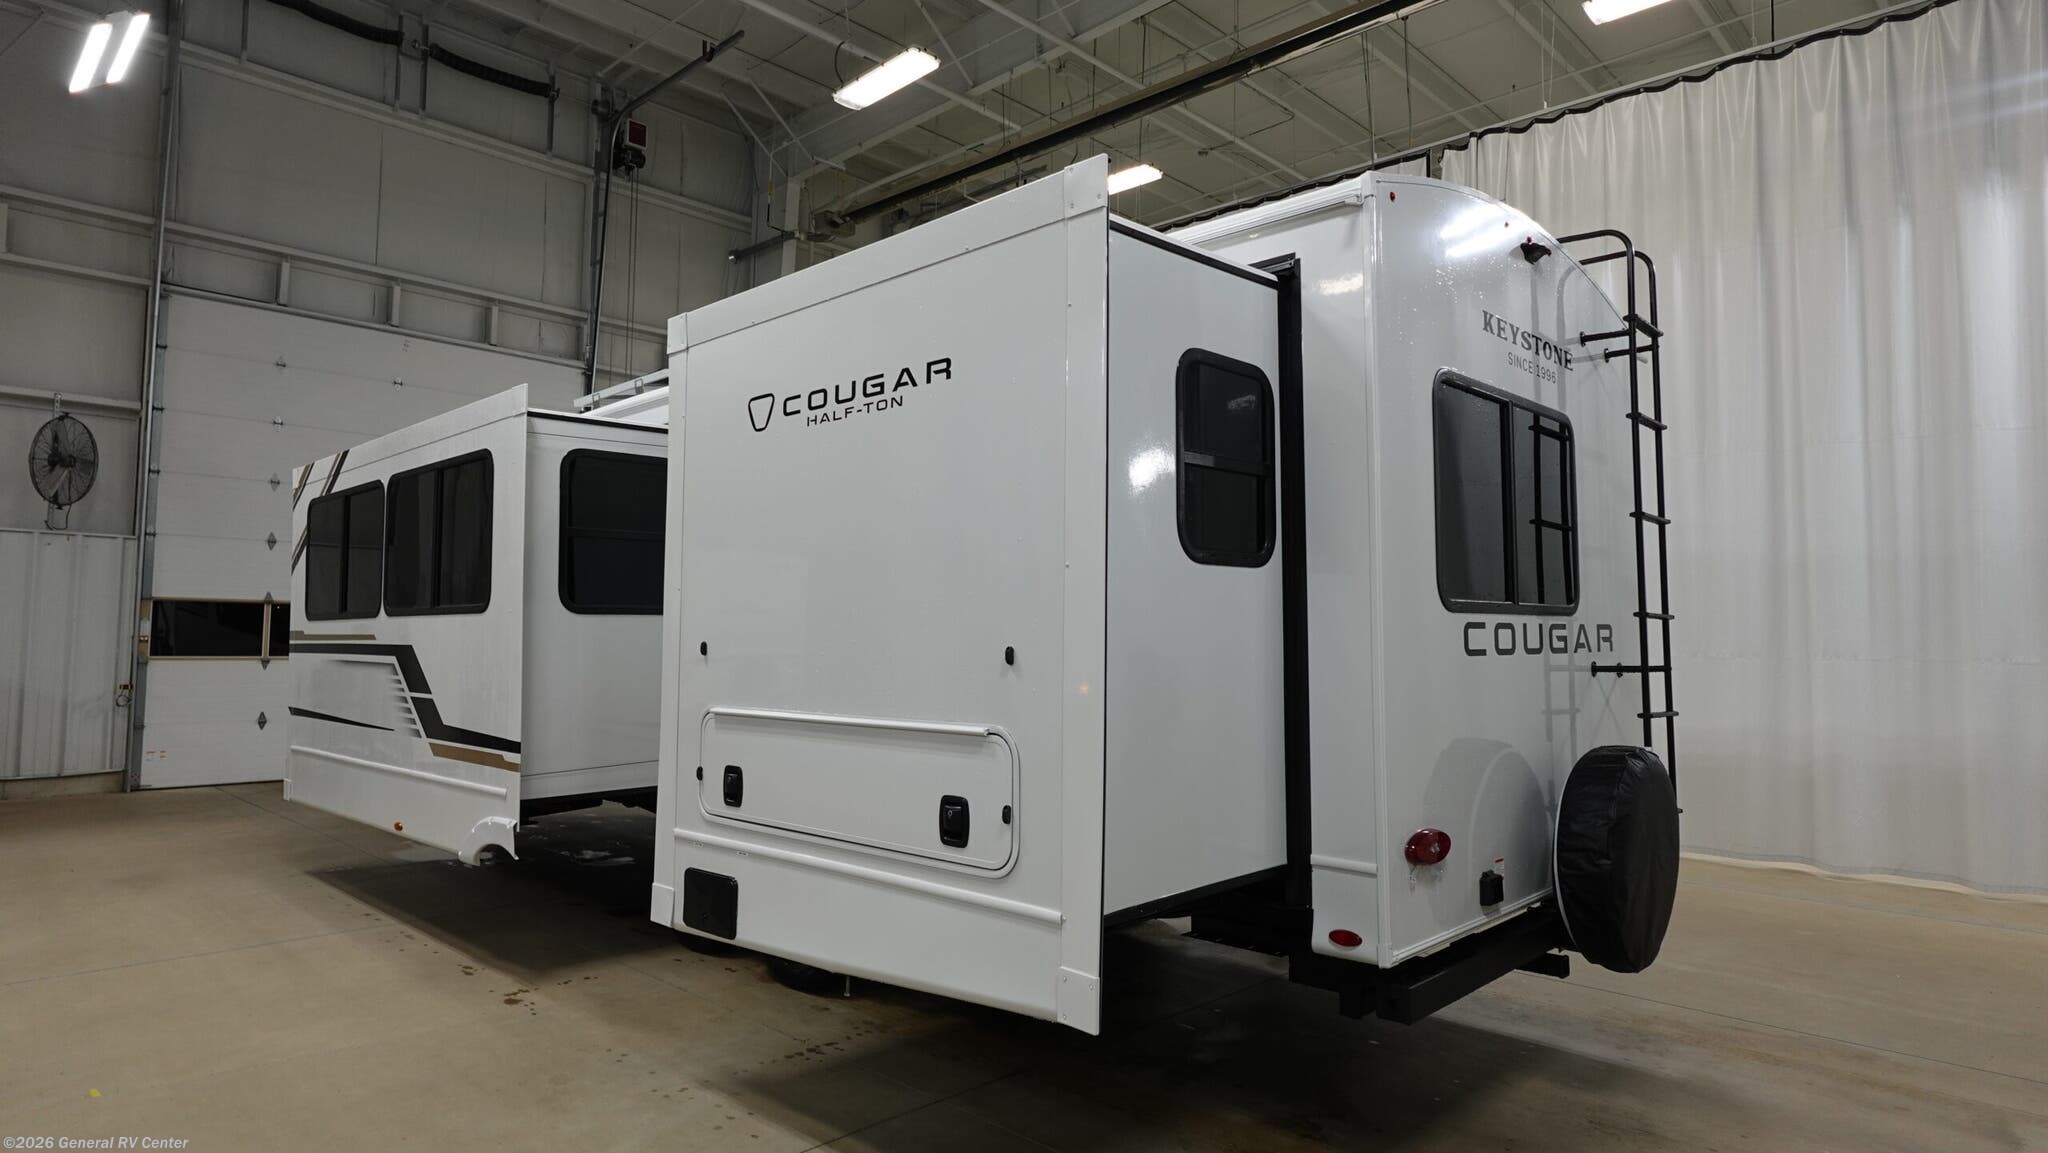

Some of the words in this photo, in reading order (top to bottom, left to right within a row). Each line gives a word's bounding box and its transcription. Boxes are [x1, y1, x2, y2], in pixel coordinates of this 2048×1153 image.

[1482, 310, 1573, 371] KEYSTONE
[1508, 352, 1533, 374] SINCE
[1536, 364, 1557, 384] 1996
[783, 357, 952, 417] COUGAR
[807, 395, 903, 427] HALF-TON
[1463, 621, 1614, 657] COUGAR
